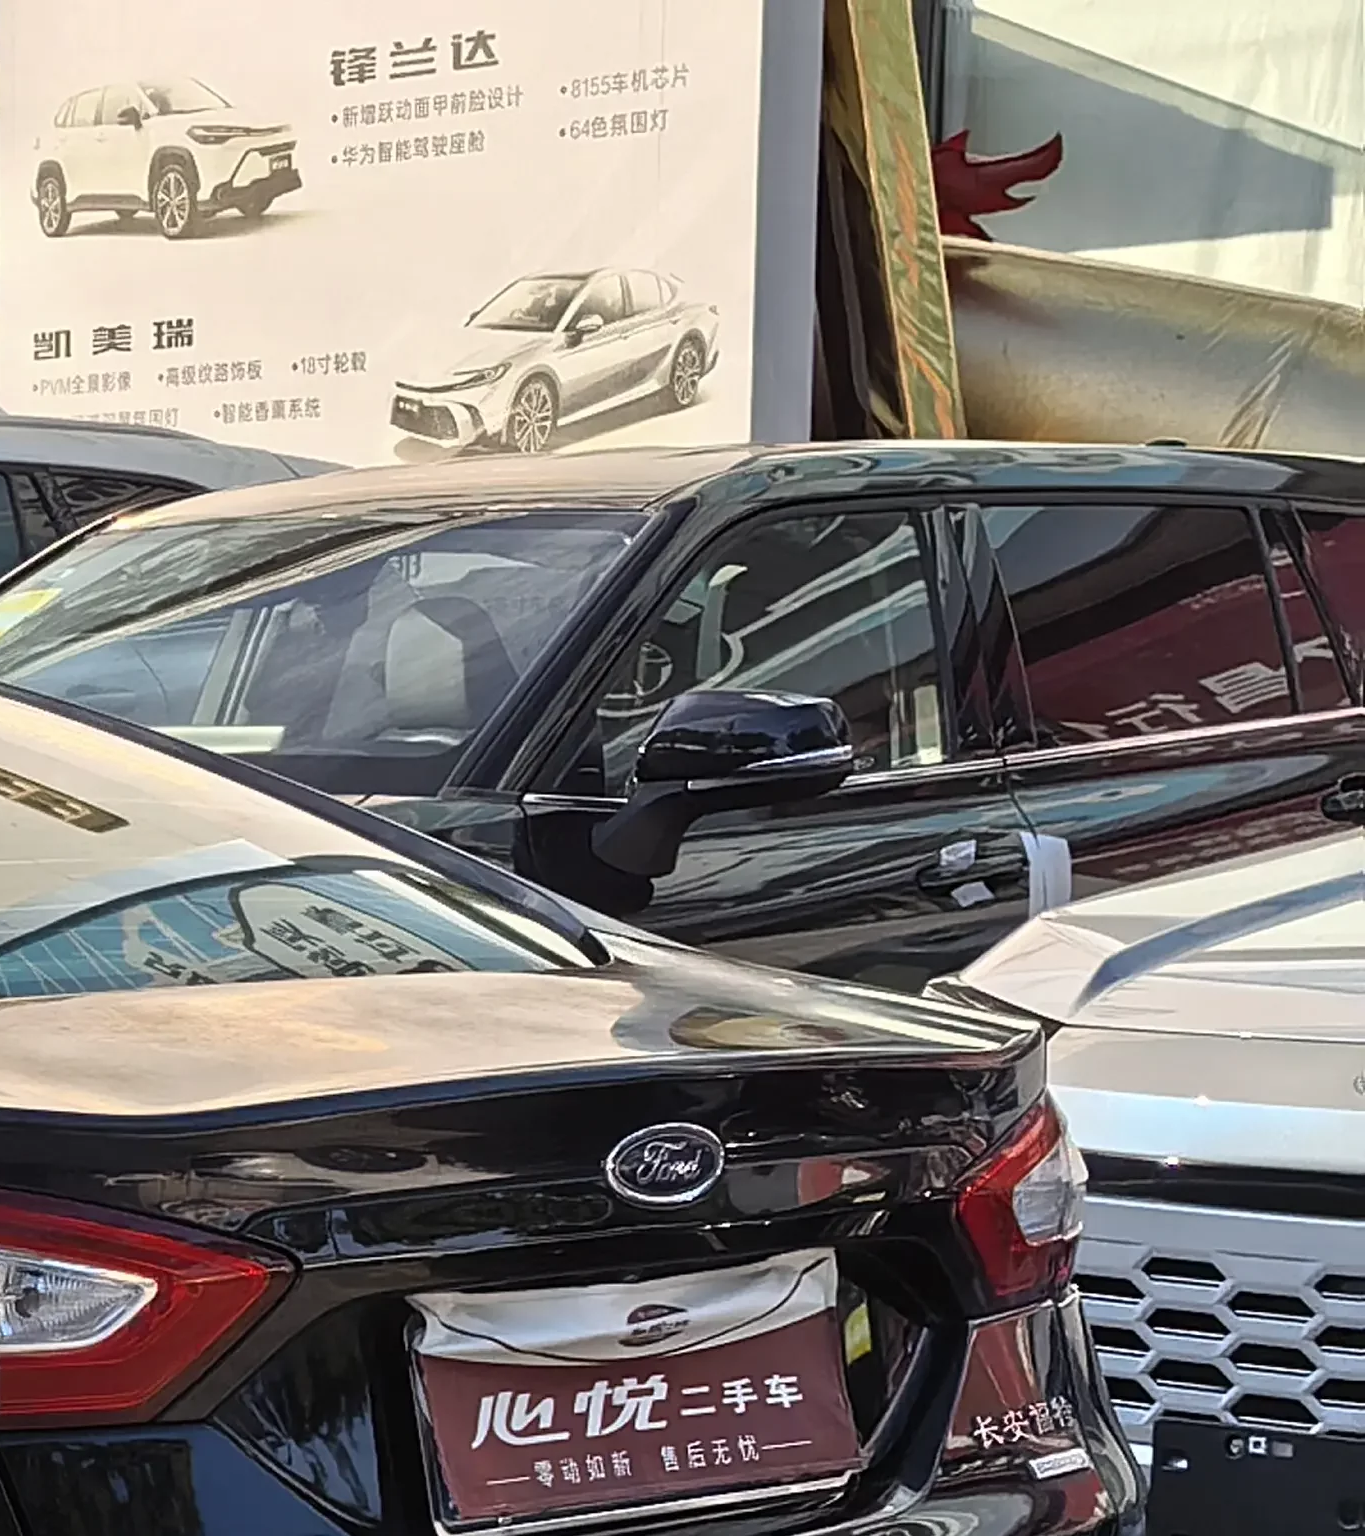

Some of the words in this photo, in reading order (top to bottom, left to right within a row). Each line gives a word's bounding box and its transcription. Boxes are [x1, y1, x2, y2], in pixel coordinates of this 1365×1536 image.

[329, 30, 499, 87] 锋兰达
[571, 62, 690, 99] 8155车机芯片
[569, 108, 669, 140] 64色氛围灯
[342, 130, 486, 167] 华为智能驾驶座舱
[33, 318, 194, 361] 凯美瑞
[636, 1141, 702, 1185] Ford
[973, 1395, 1073, 1450] 长安福特
[660, 1433, 761, 1473] 售后无忧
